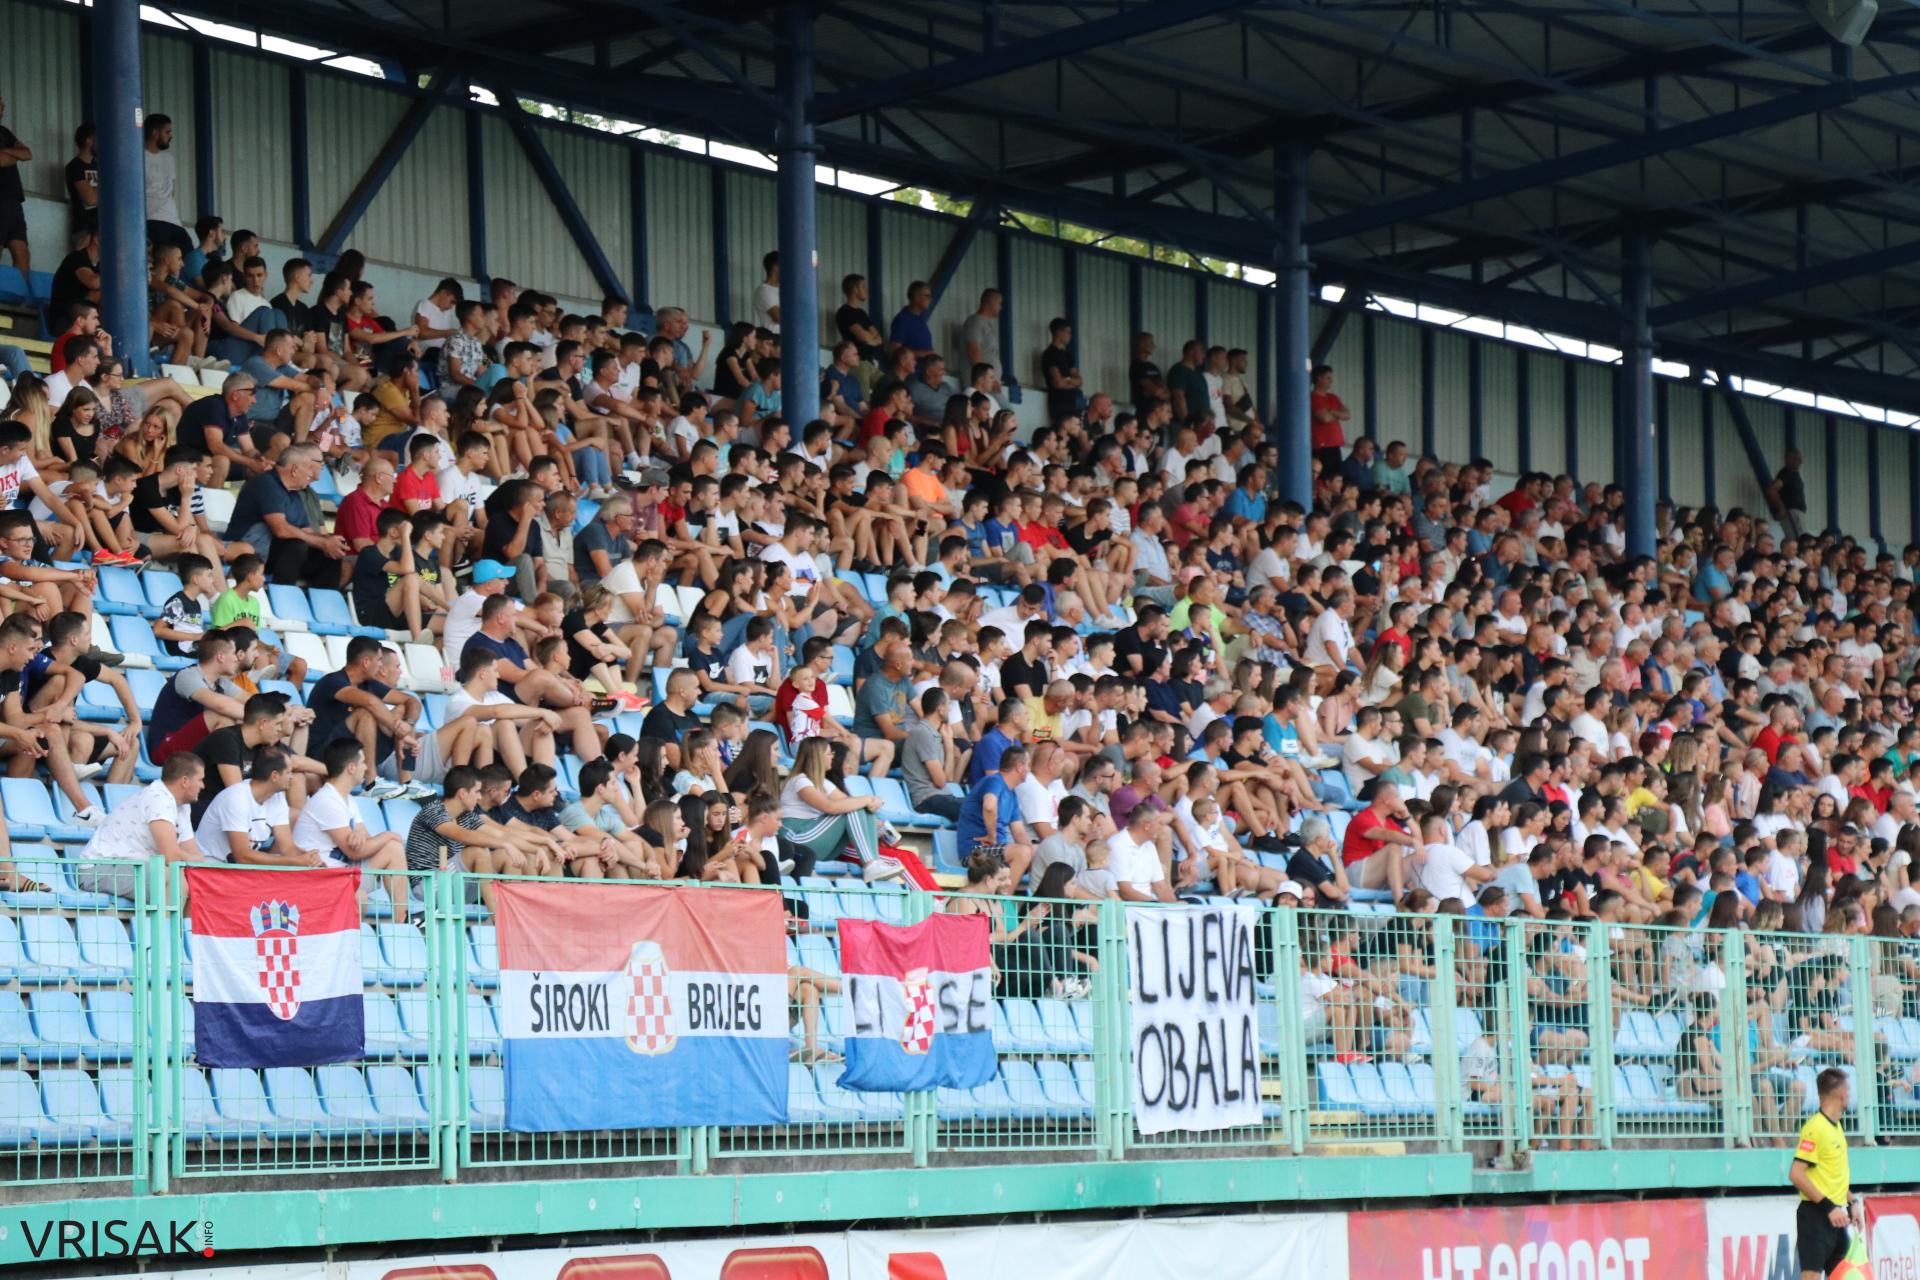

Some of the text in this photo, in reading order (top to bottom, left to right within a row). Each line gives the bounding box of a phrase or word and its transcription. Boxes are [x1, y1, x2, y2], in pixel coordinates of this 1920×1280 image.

[530, 972, 762, 1033] ŠIROKI BRIJEG
[1134, 911, 1255, 1006] LIJEVA
[1139, 1014, 1259, 1111] OBALA
